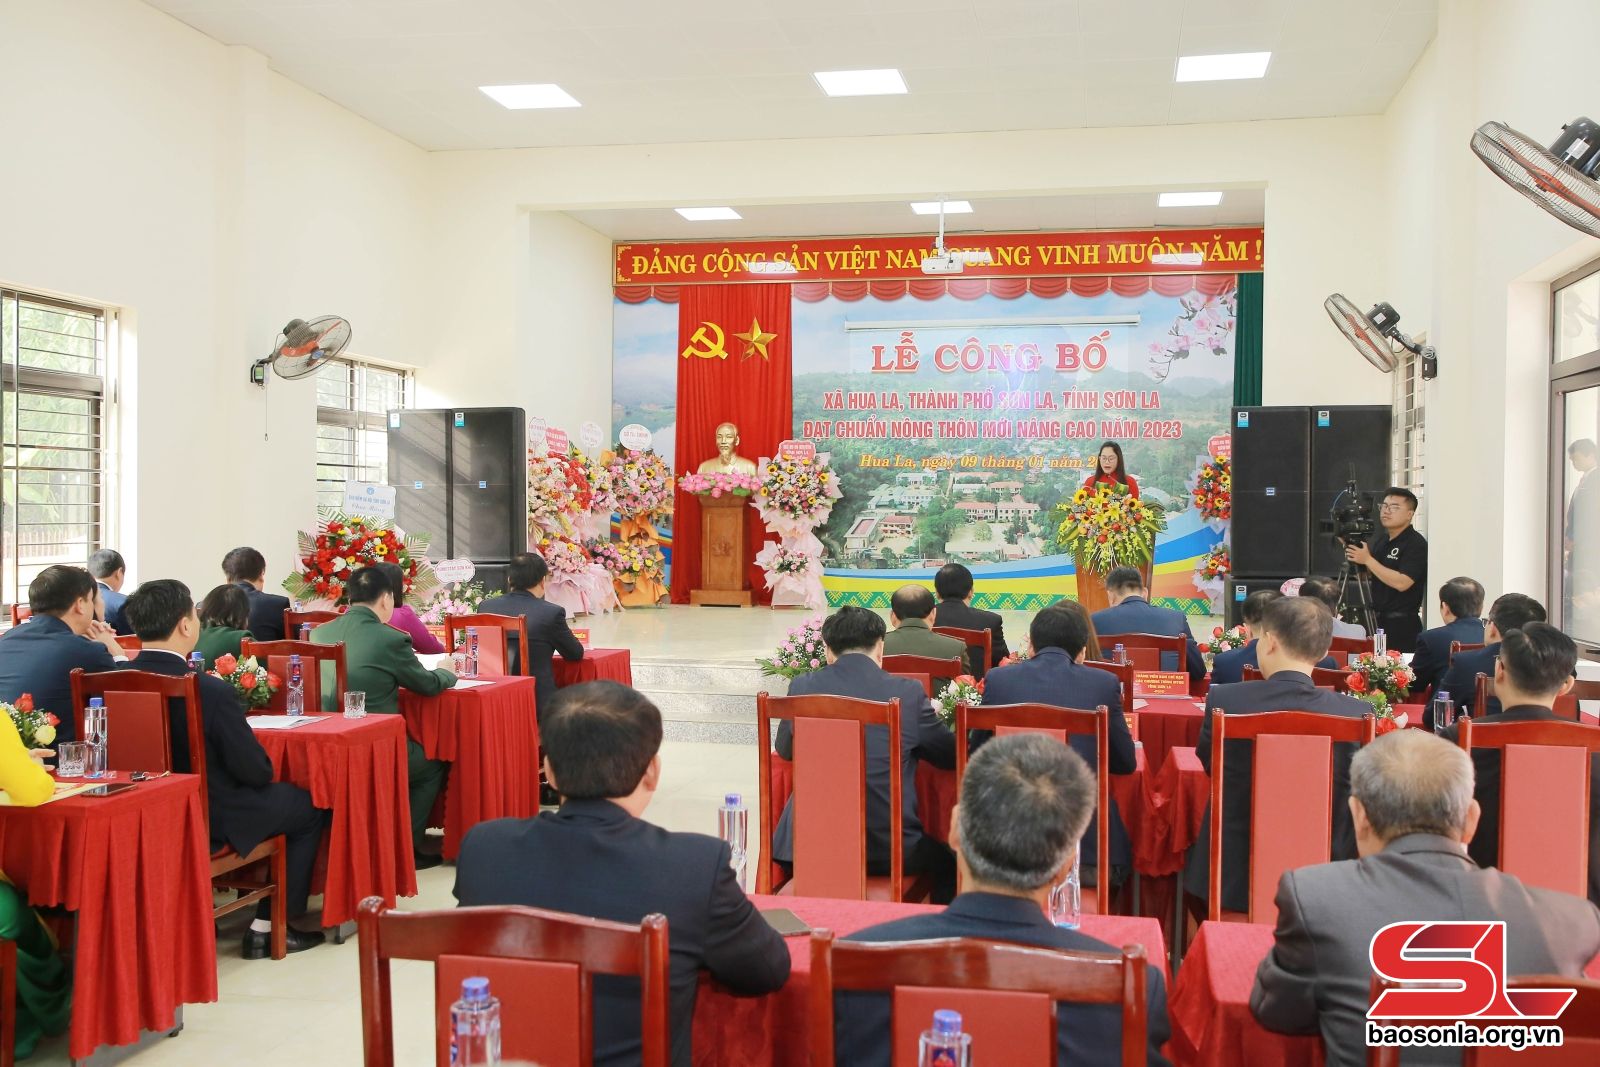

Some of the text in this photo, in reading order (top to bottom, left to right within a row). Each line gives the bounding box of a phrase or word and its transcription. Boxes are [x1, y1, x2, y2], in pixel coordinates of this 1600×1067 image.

[632, 248, 697, 274] ĐẢNG
[703, 248, 768, 278] CỘNG
[773, 244, 820, 273] SẢN
[824, 244, 880, 275] VIỆT
[949, 246, 1032, 267] UANG
[1036, 244, 1100, 266] VINH
[1106, 237, 1185, 264] MUÔN
[1191, 234, 1249, 262] NĂM
[1255, 240, 1262, 261] !
[871, 329, 1112, 372] LỄ CÔNG BỐ
[823, 385, 1160, 412] XÃ HUA LA, THÀNH PHỐ SƠN LA, TỈNH SƠN LA
[803, 415, 1182, 442] ĐẠT CHUẨN NÔNG THÔN MỚI NÂNG CAO NĂM 2023
[859, 454, 889, 468] Hua
[893, 454, 917, 470] La,
[921, 454, 957, 470] ngày
[960, 455, 978, 468] 09
[981, 454, 1025, 470] tháng
[1028, 455, 1045, 468] 01
[1049, 455, 1083, 468] năm
